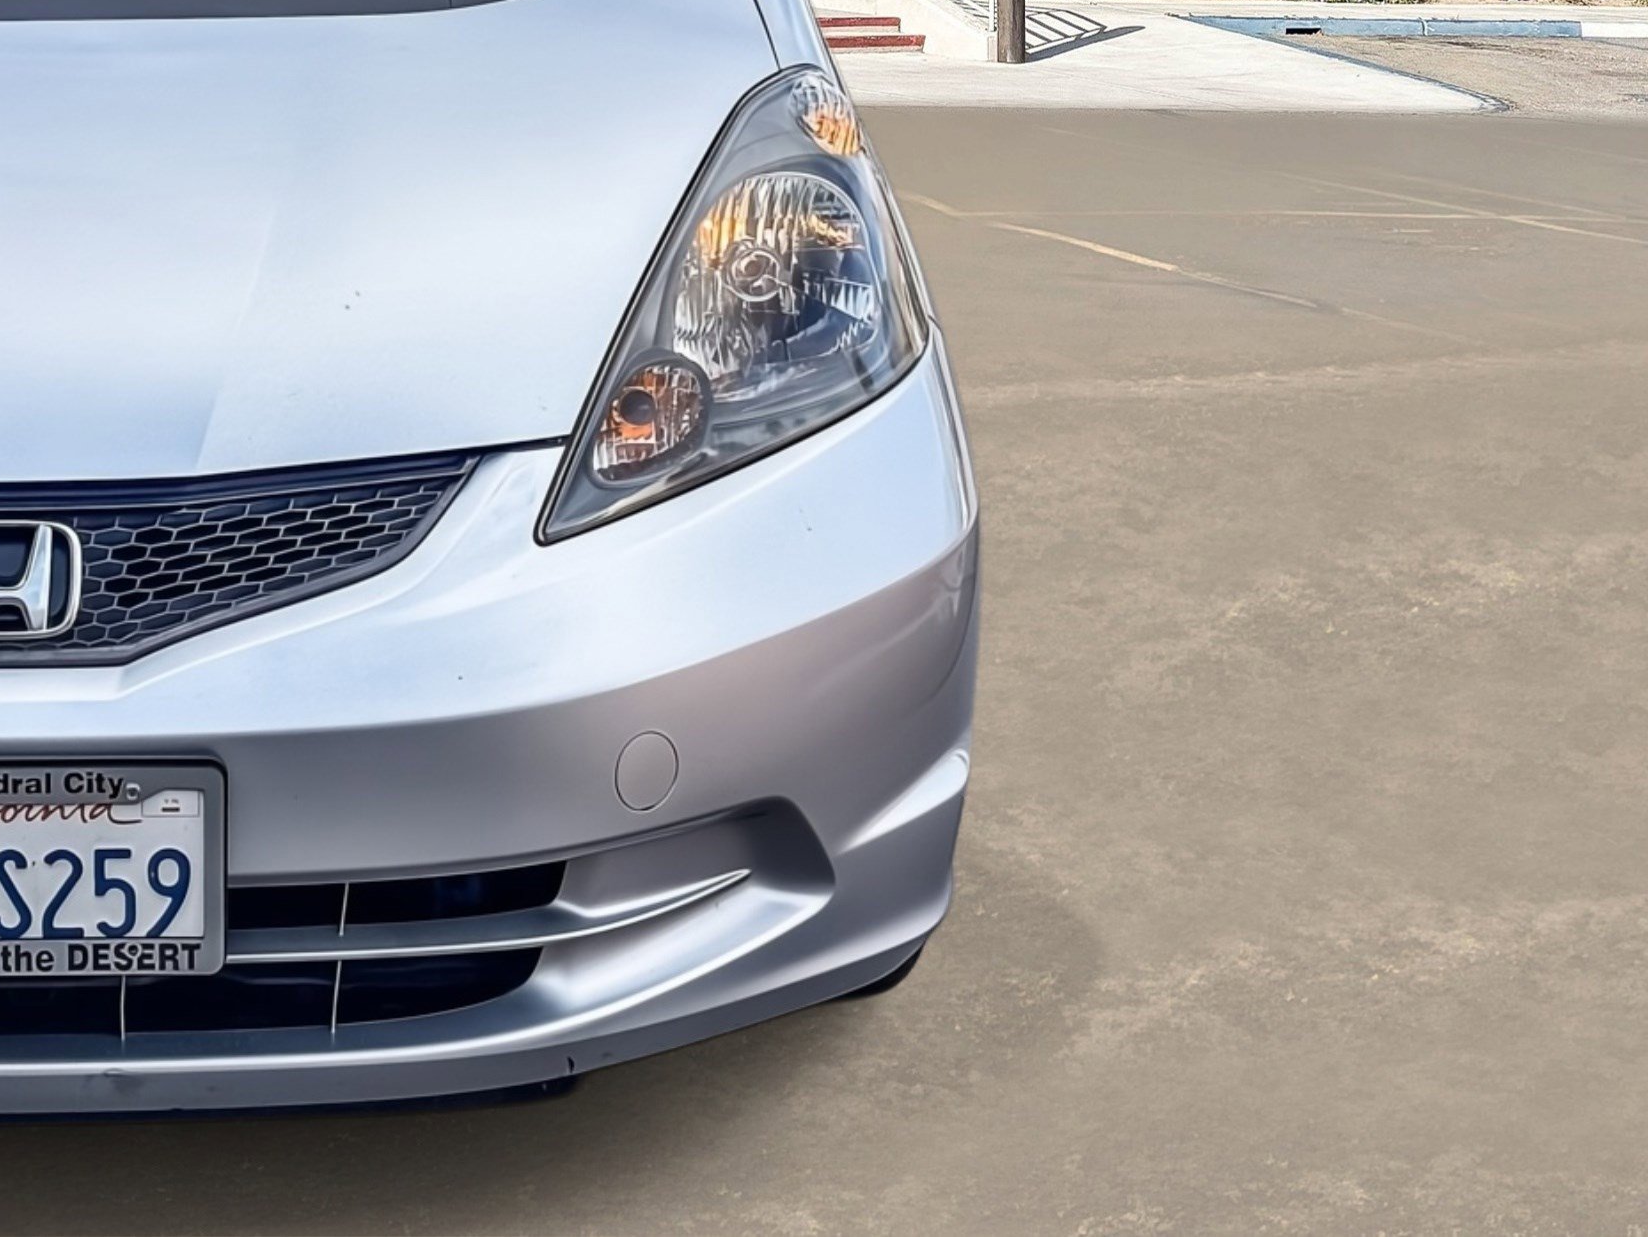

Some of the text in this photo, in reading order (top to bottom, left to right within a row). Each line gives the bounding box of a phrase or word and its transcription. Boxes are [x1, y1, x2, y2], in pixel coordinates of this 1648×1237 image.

[63, 771, 125, 799] City
[1, 945, 54, 973] the
[68, 942, 202, 972] DESERT
